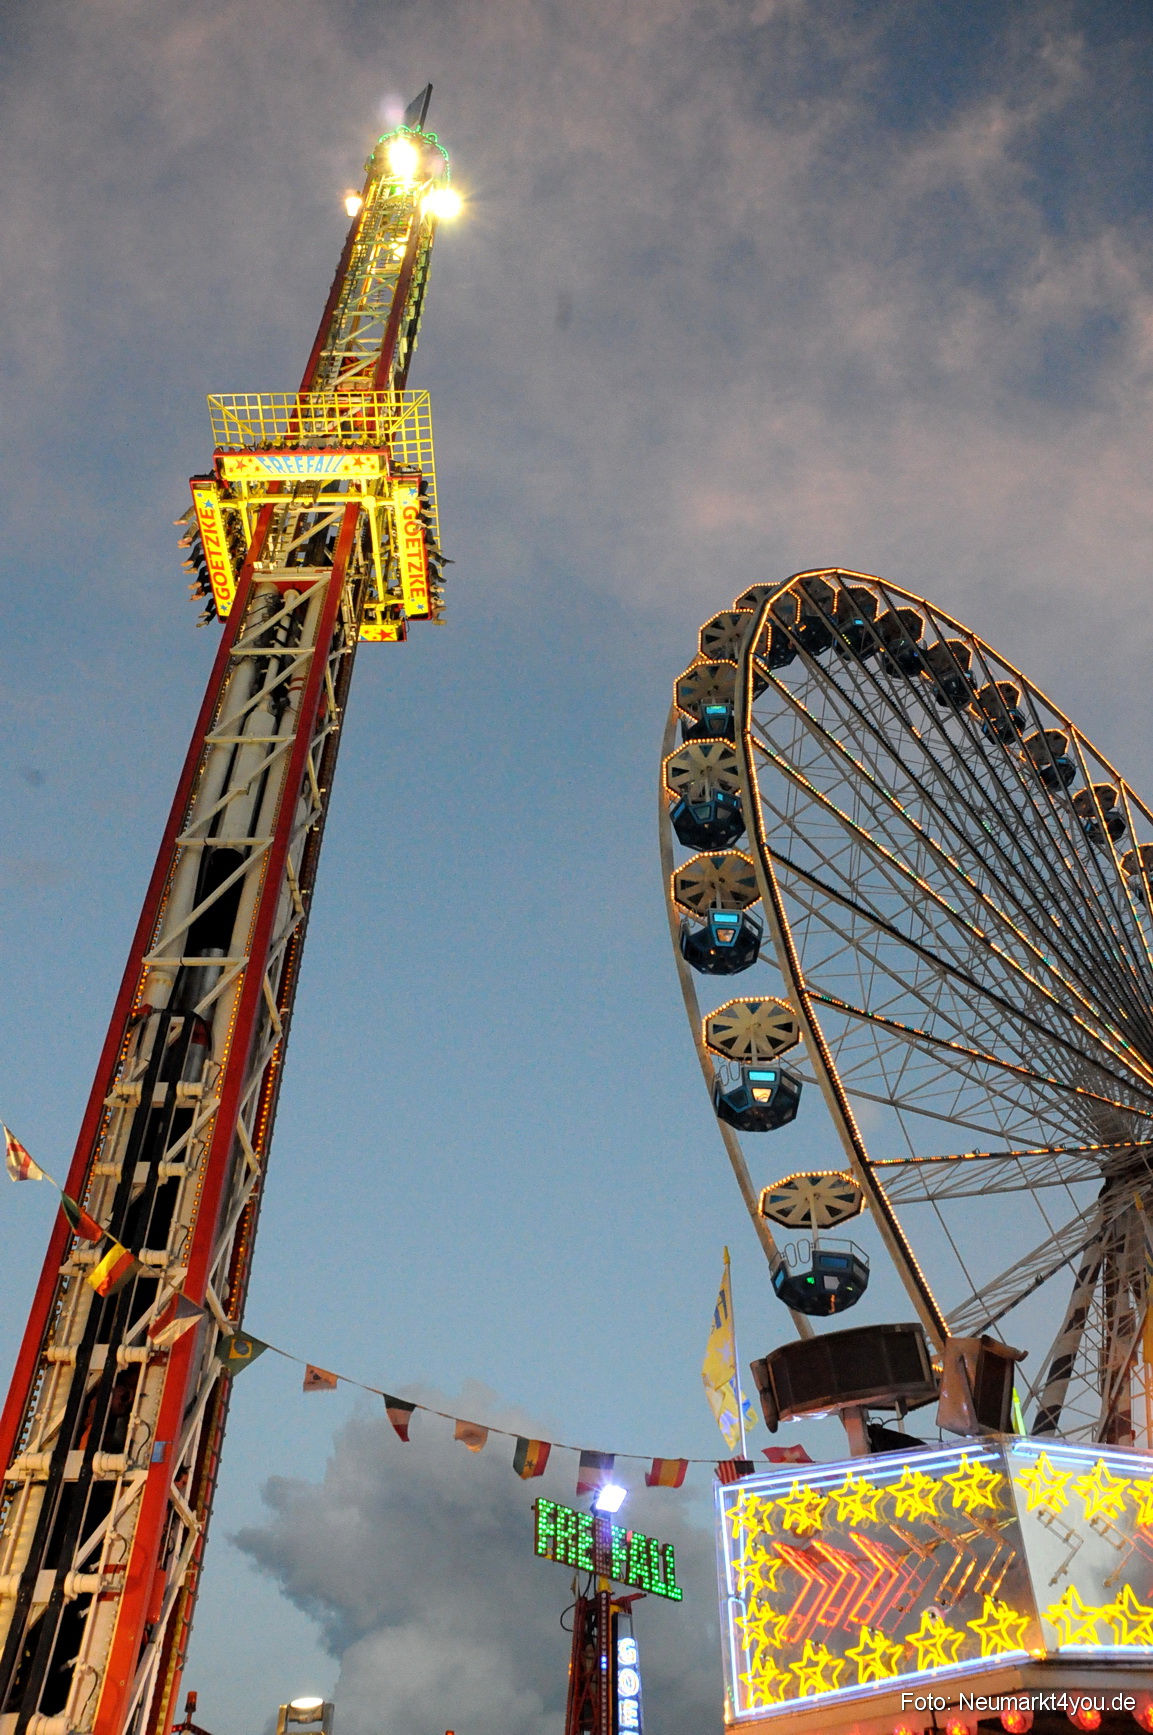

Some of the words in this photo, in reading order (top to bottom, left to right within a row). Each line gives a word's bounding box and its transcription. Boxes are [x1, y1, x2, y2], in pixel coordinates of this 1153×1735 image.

[255, 455, 348, 474] FREEFALL
[198, 507, 231, 601] GOETZKE
[402, 505, 427, 598] GOETZKE
[617, 1637, 640, 1735] GOE
